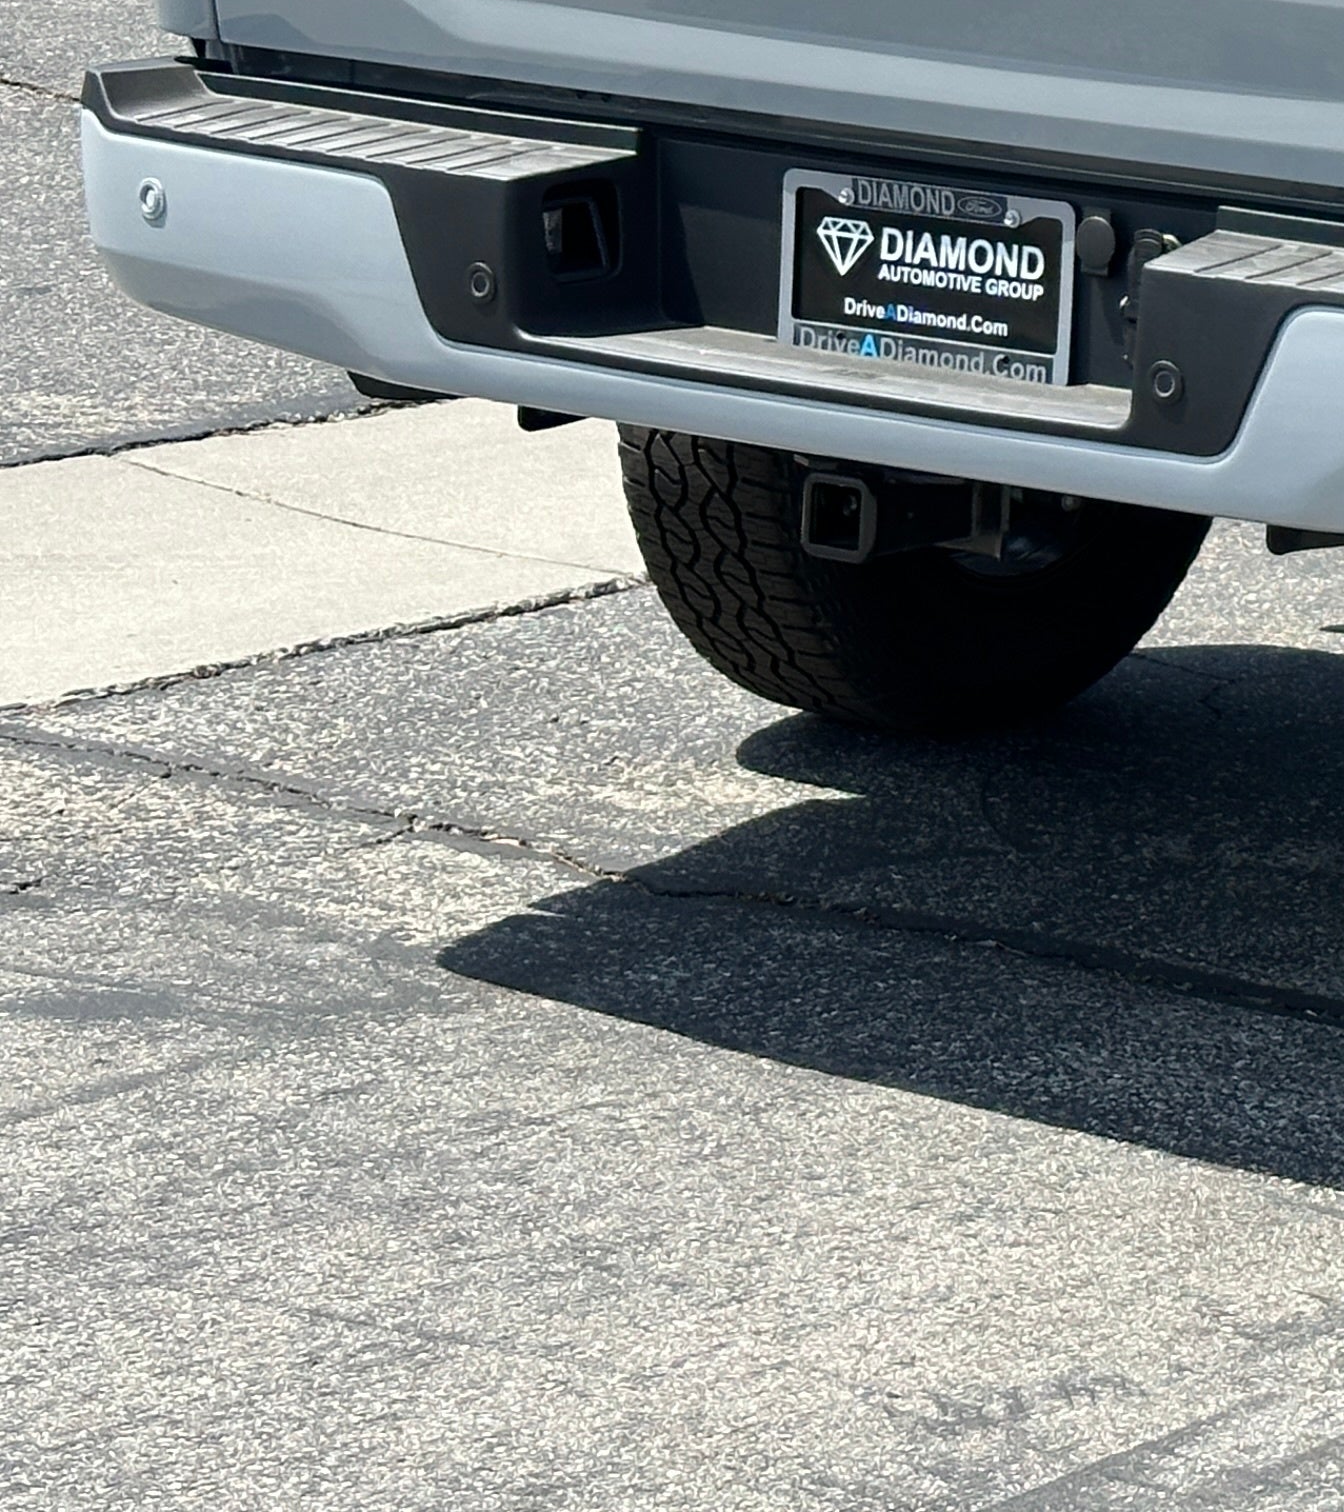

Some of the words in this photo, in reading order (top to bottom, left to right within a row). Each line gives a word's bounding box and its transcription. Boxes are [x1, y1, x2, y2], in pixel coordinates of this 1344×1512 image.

[857, 178, 956, 217] DIAMOND
[879, 227, 1045, 281] DIAMOND
[877, 263, 982, 295] AUTOMOTIVE
[985, 278, 1045, 302] GROUP
[843, 296, 1009, 337] DriveADiamond.Com
[799, 325, 1048, 385] DriveADiamond.Com
